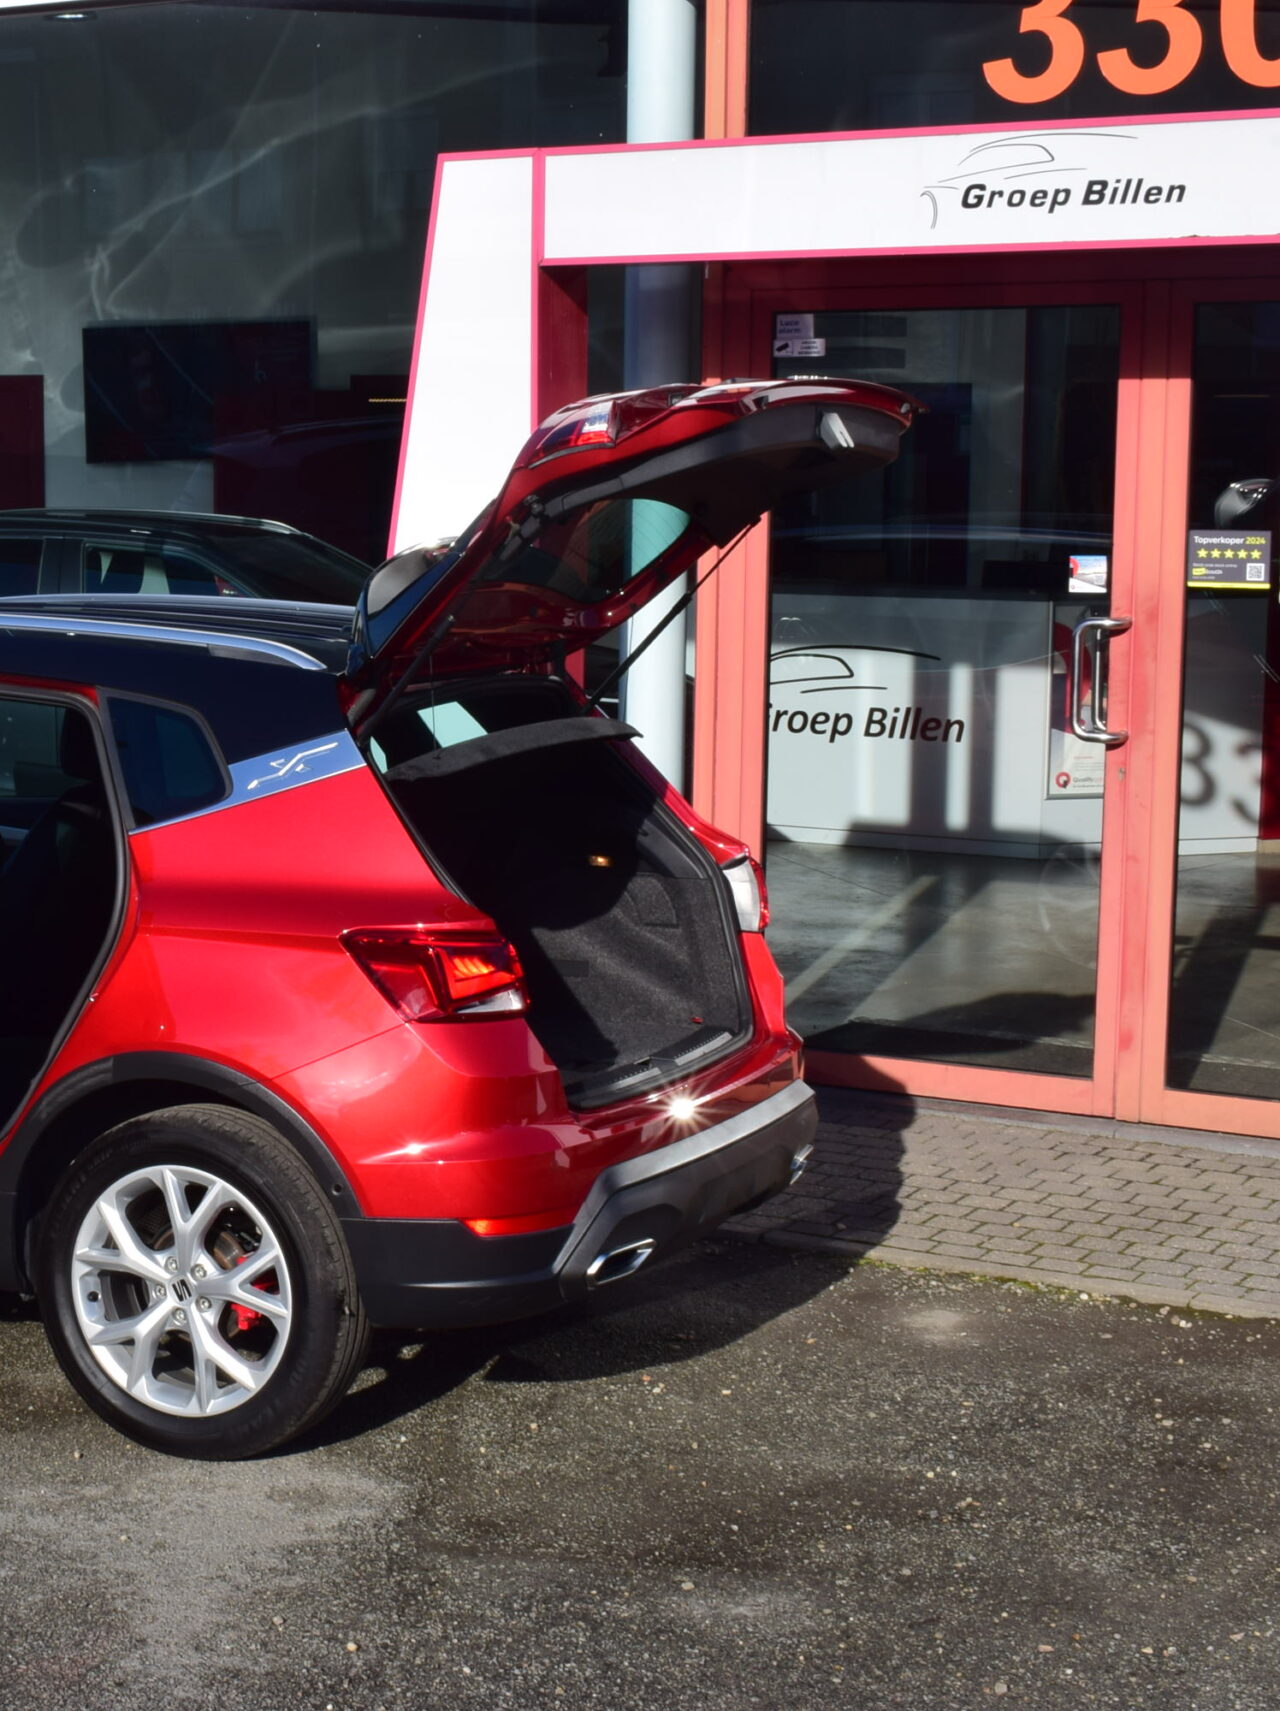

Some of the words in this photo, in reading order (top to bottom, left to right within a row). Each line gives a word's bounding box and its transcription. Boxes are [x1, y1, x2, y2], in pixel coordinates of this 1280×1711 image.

[961, 183, 1072, 214] Groep
[1081, 178, 1187, 206] Billen
[1194, 535, 1245, 546] Topverkoper
[1245, 536, 1267, 545] 2024
[863, 706, 966, 743] Billen
